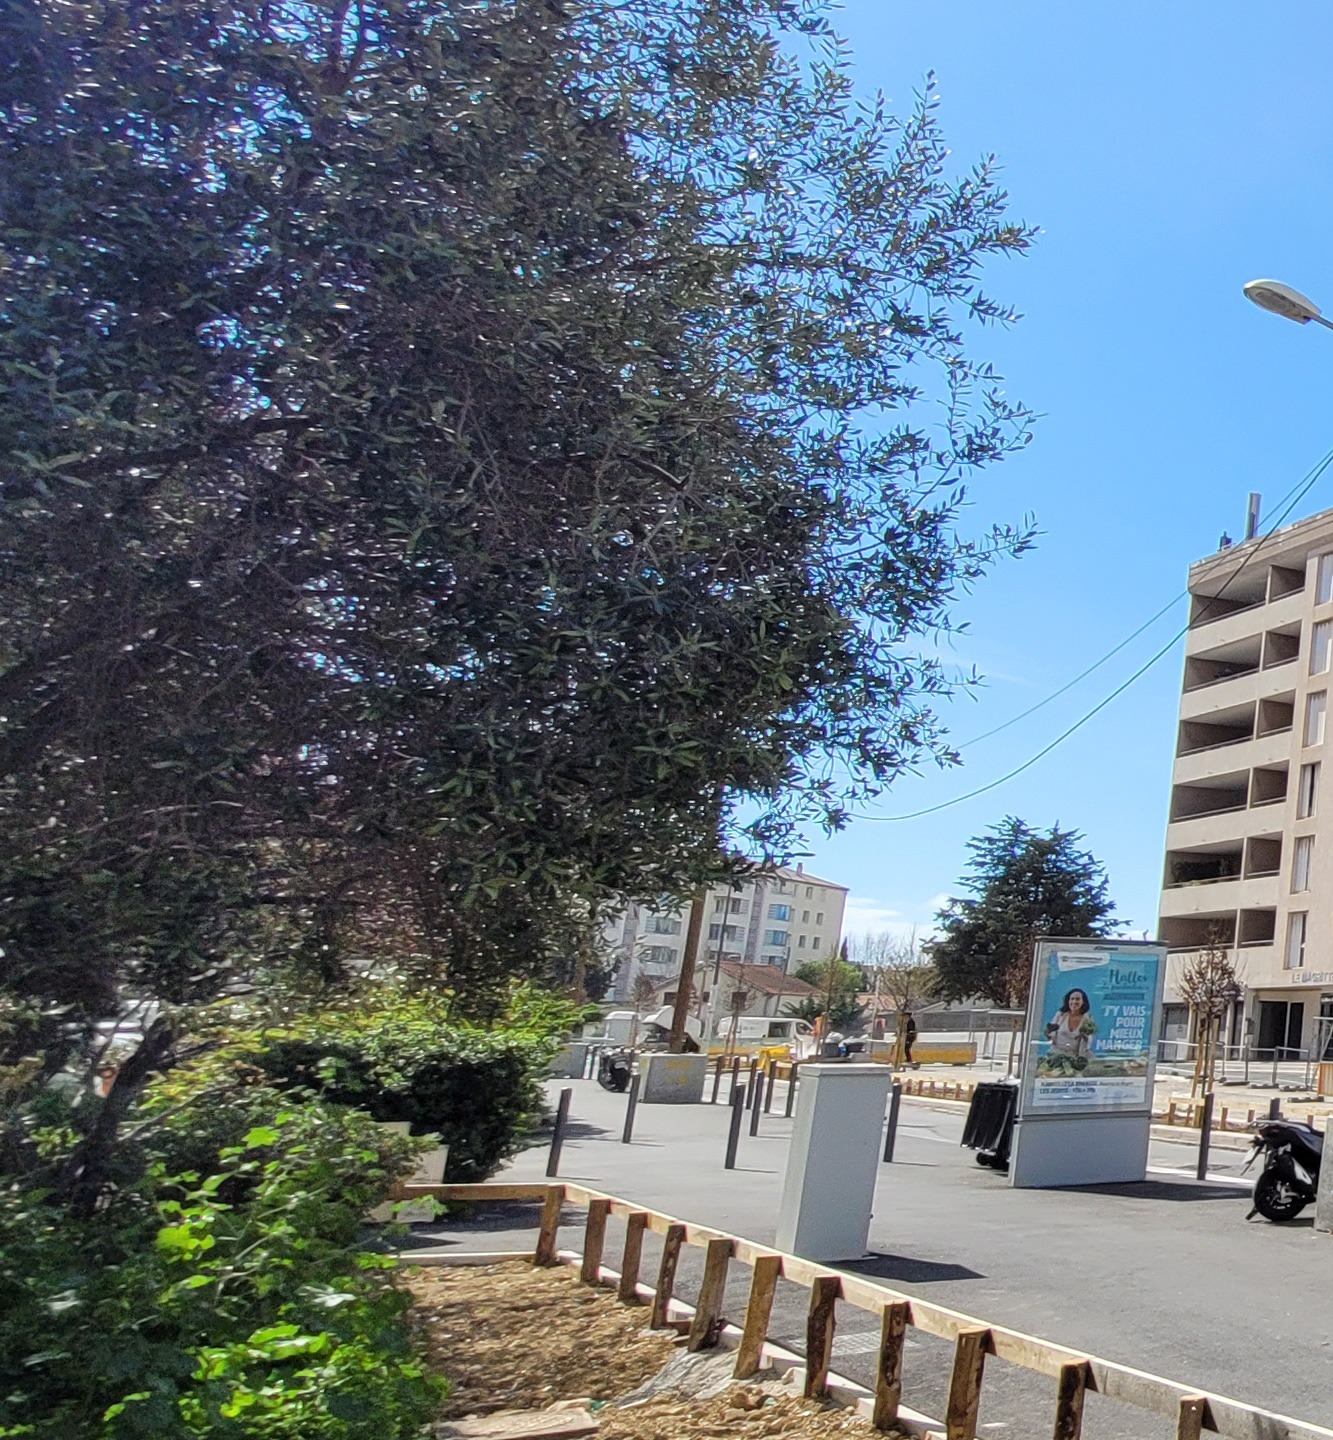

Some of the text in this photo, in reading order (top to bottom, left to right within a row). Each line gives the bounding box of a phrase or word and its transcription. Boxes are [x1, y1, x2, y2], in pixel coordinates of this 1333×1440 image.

[1122, 1005, 1146, 1016] VAIS
[1115, 1017, 1146, 1028] POUR
[1109, 1028, 1144, 1039] MIEUX
[1095, 1039, 1144, 1051] MANGER
